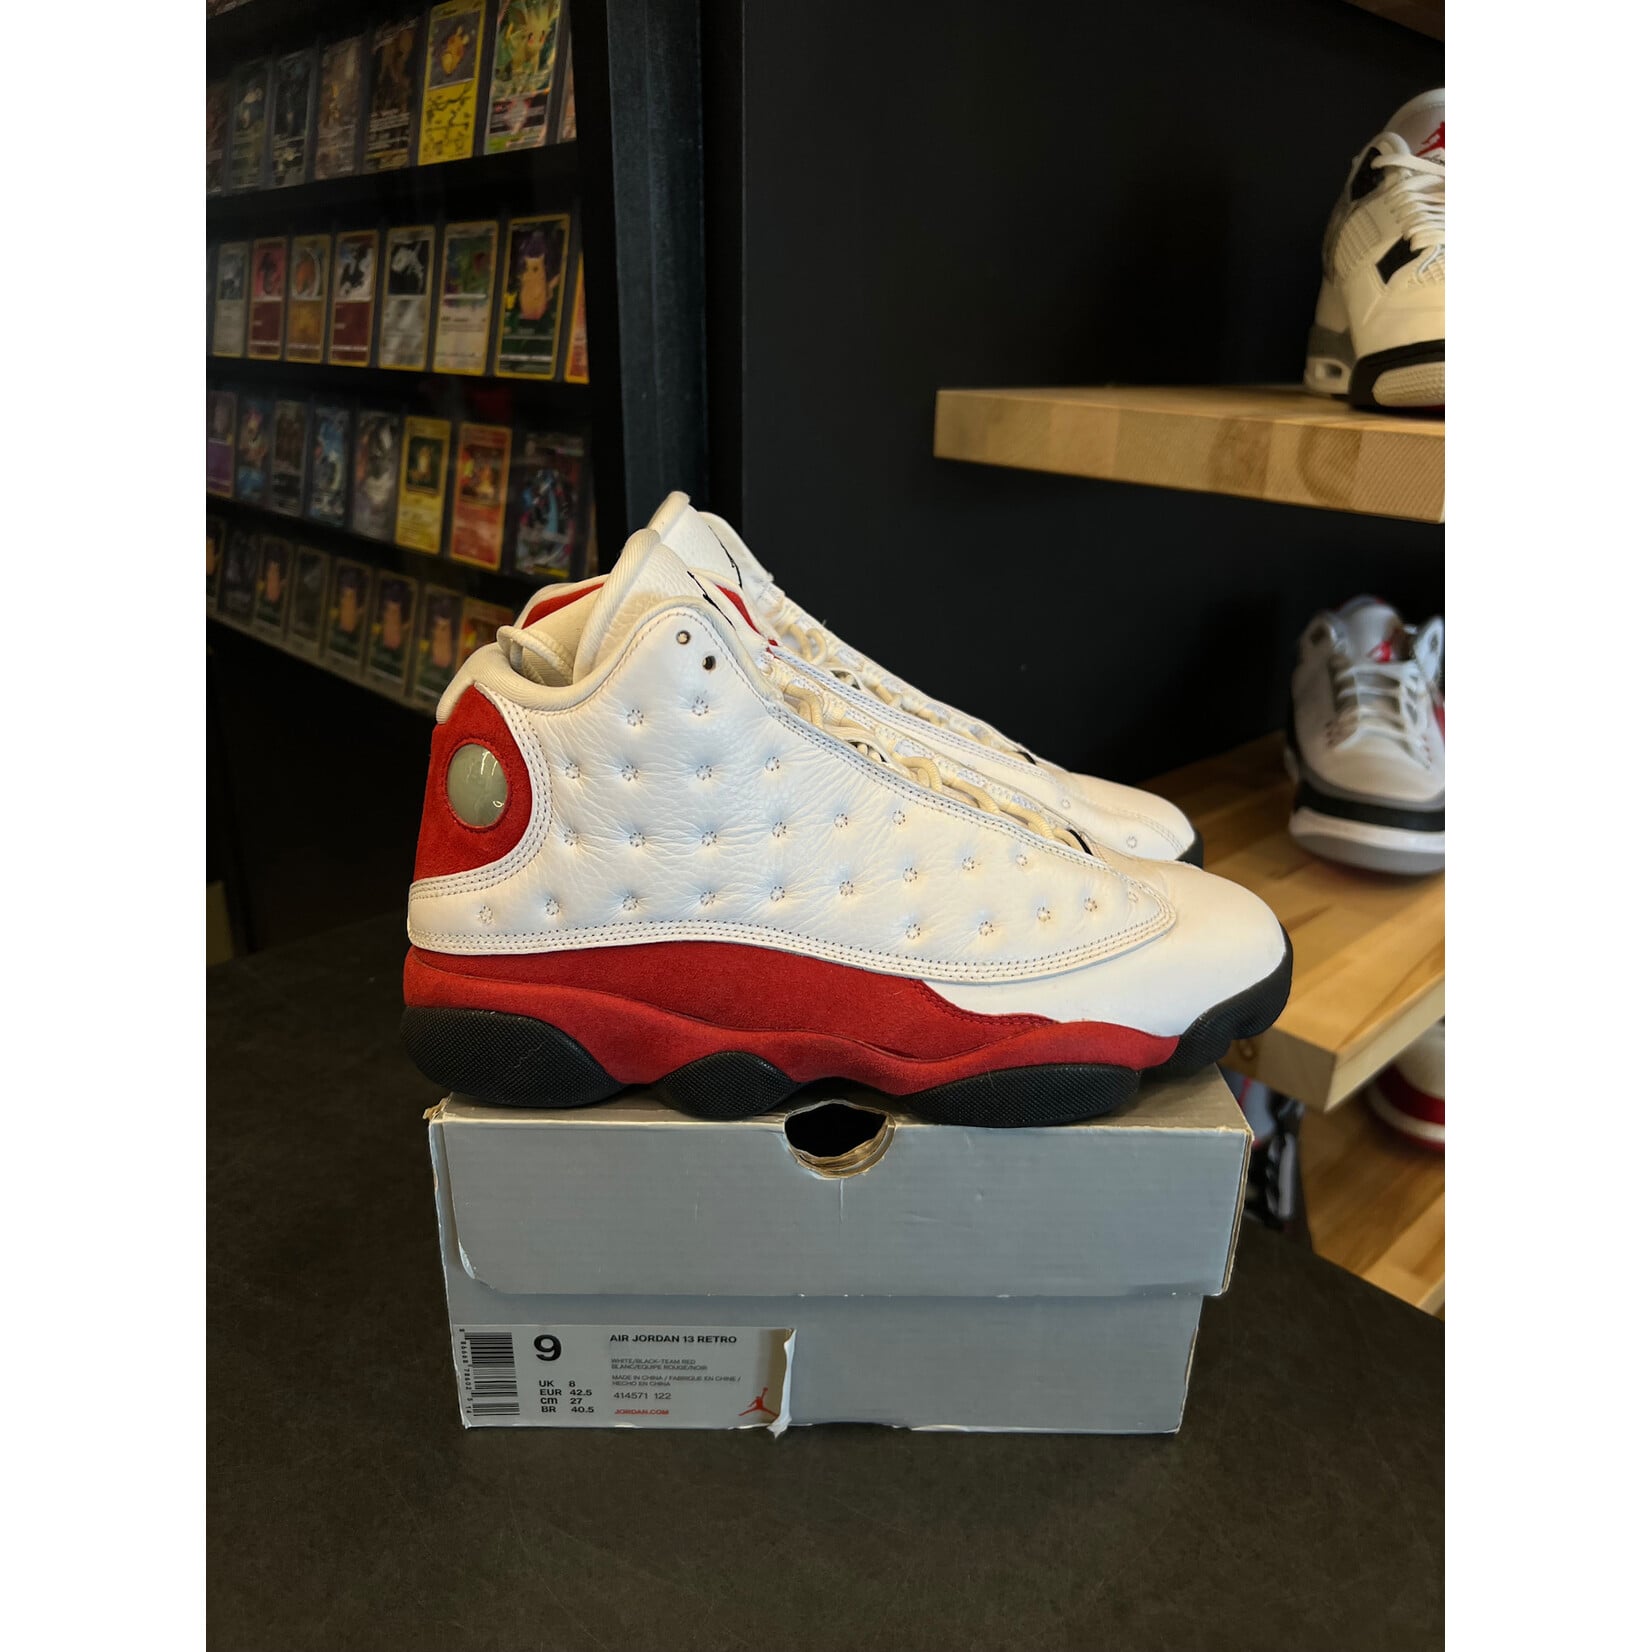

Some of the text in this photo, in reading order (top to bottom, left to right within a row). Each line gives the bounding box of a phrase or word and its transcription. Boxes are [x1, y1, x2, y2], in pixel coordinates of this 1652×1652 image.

[610, 1334, 737, 1344] AIR JORDAN 13 RETRO
[533, 1334, 562, 1361] 9
[568, 1380, 576, 1388] 8
[613, 1392, 672, 1400] 414571 122
[540, 1397, 582, 1405] cm 27
